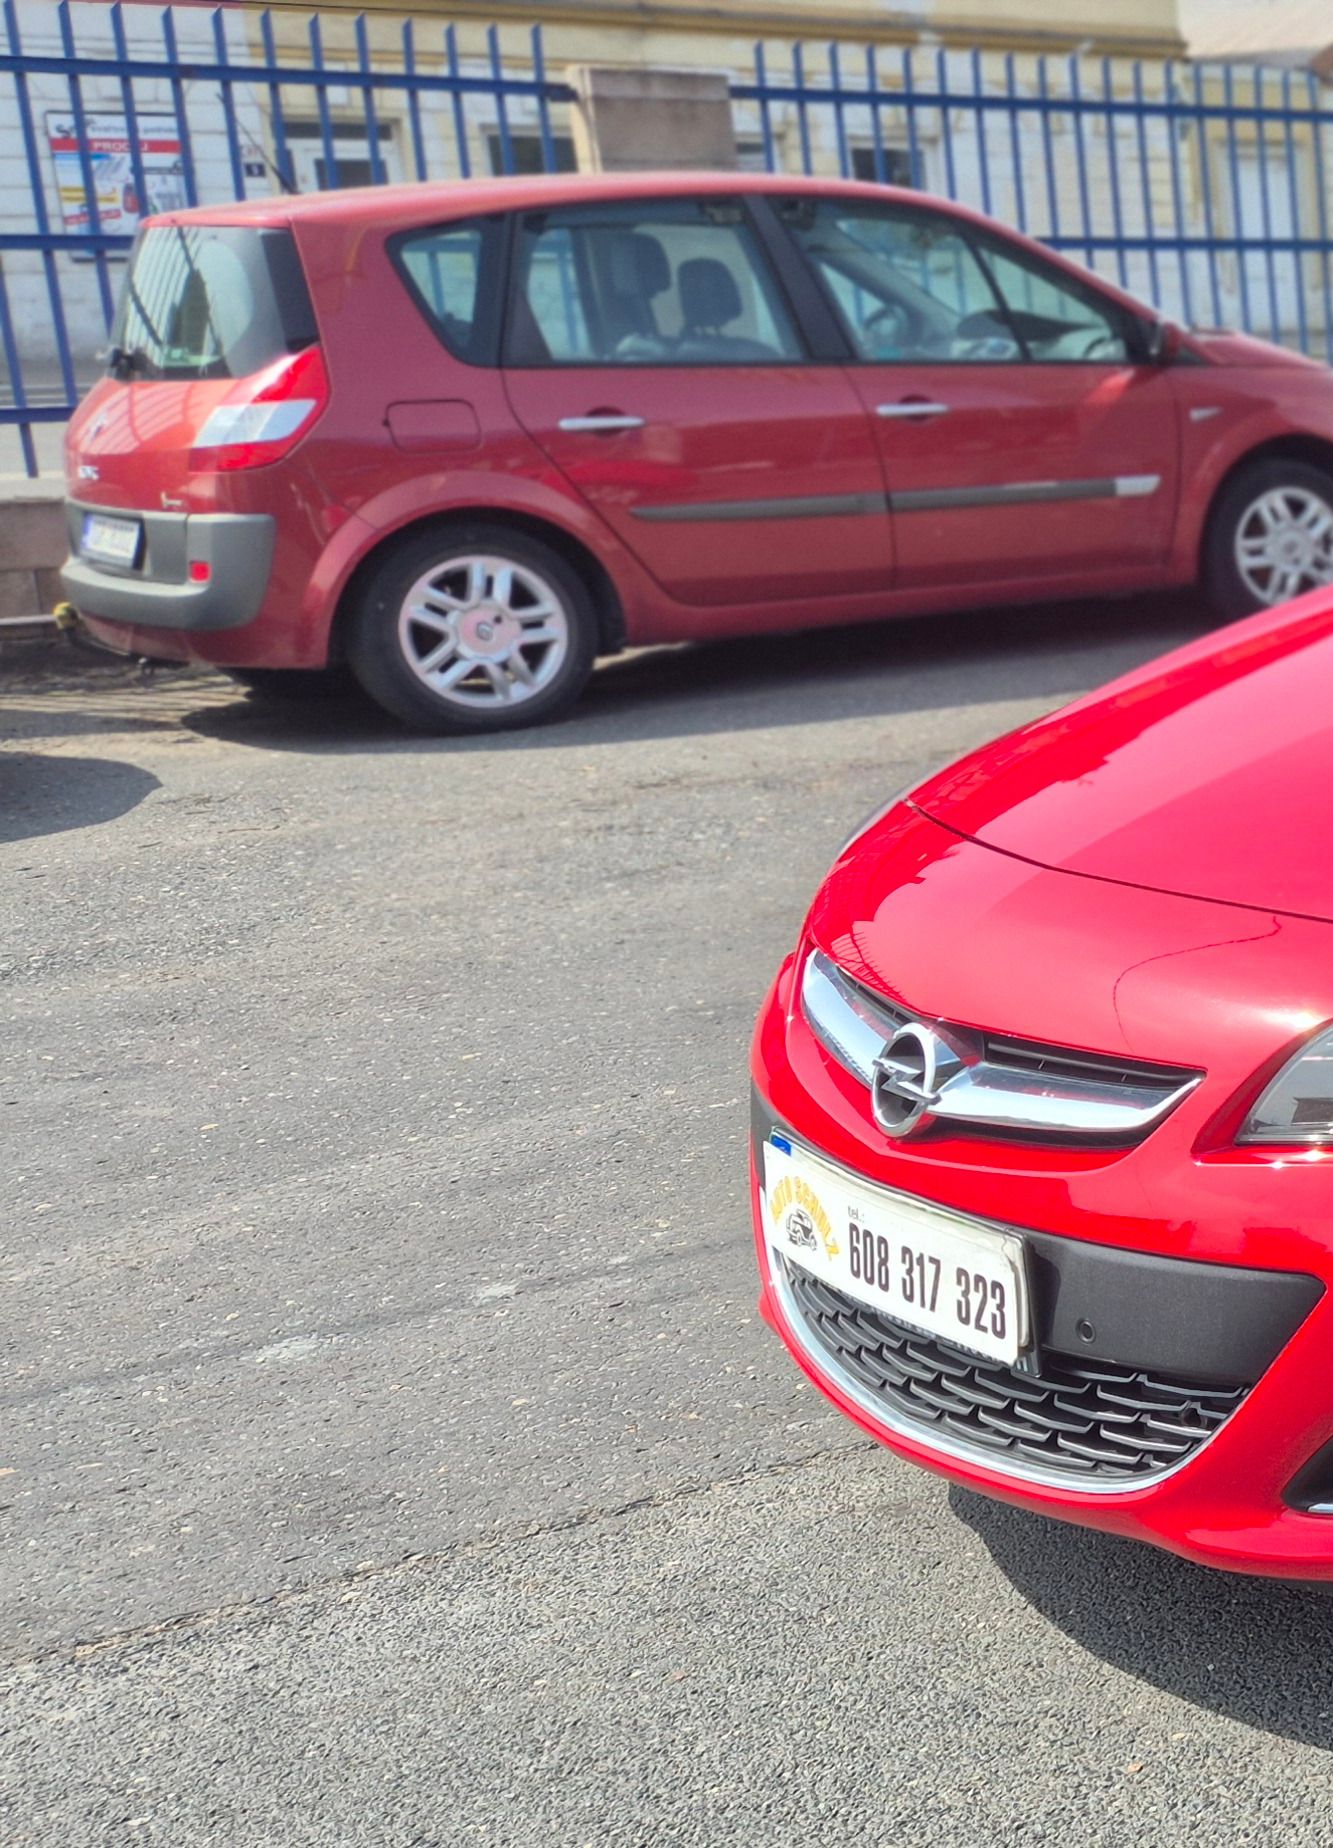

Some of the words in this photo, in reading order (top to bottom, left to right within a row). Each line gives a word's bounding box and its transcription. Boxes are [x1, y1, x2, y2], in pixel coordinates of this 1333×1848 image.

[847, 1205, 865, 1223] tel.:
[849, 1222, 890, 1292] 608
[901, 1245, 941, 1312] 317
[956, 1267, 1006, 1340] 323
